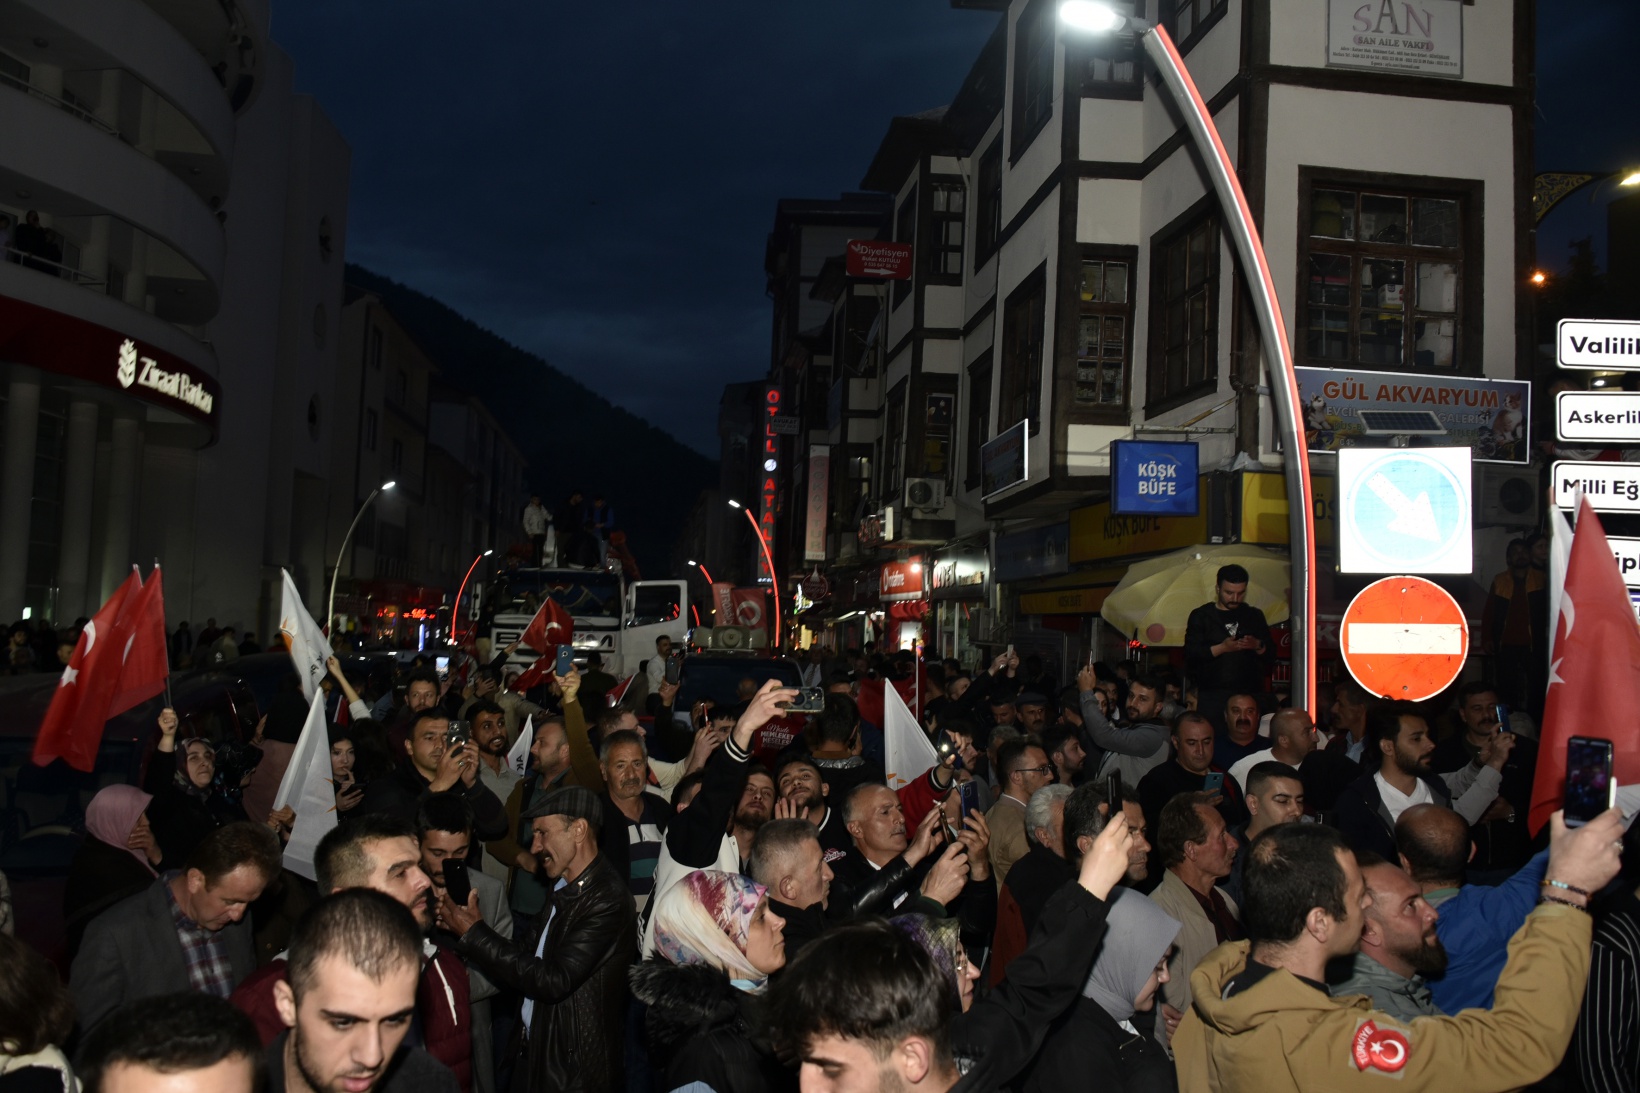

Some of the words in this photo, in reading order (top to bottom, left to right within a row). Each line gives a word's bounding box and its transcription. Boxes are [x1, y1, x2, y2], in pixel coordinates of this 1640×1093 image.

[1352, 0, 1434, 38] SAN
[1357, 36, 1376, 46] SAN
[1402, 40, 1431, 50] VAKFI
[860, 245, 908, 258] Diyetisyen
[138, 356, 180, 398] Ziraat
[1323, 377, 1369, 401] GÜL
[1375, 384, 1499, 408] AKVARYUM
[1437, 412, 1489, 425] GALERİSİ
[1137, 461, 1177, 481] KÖŞK
[1137, 480, 1177, 496] BÜFE
[1562, 478, 1606, 495] Milli
[760, 731, 795, 741] MEMLEKET
[1356, 1025, 1374, 1065] TÜRKİYE
